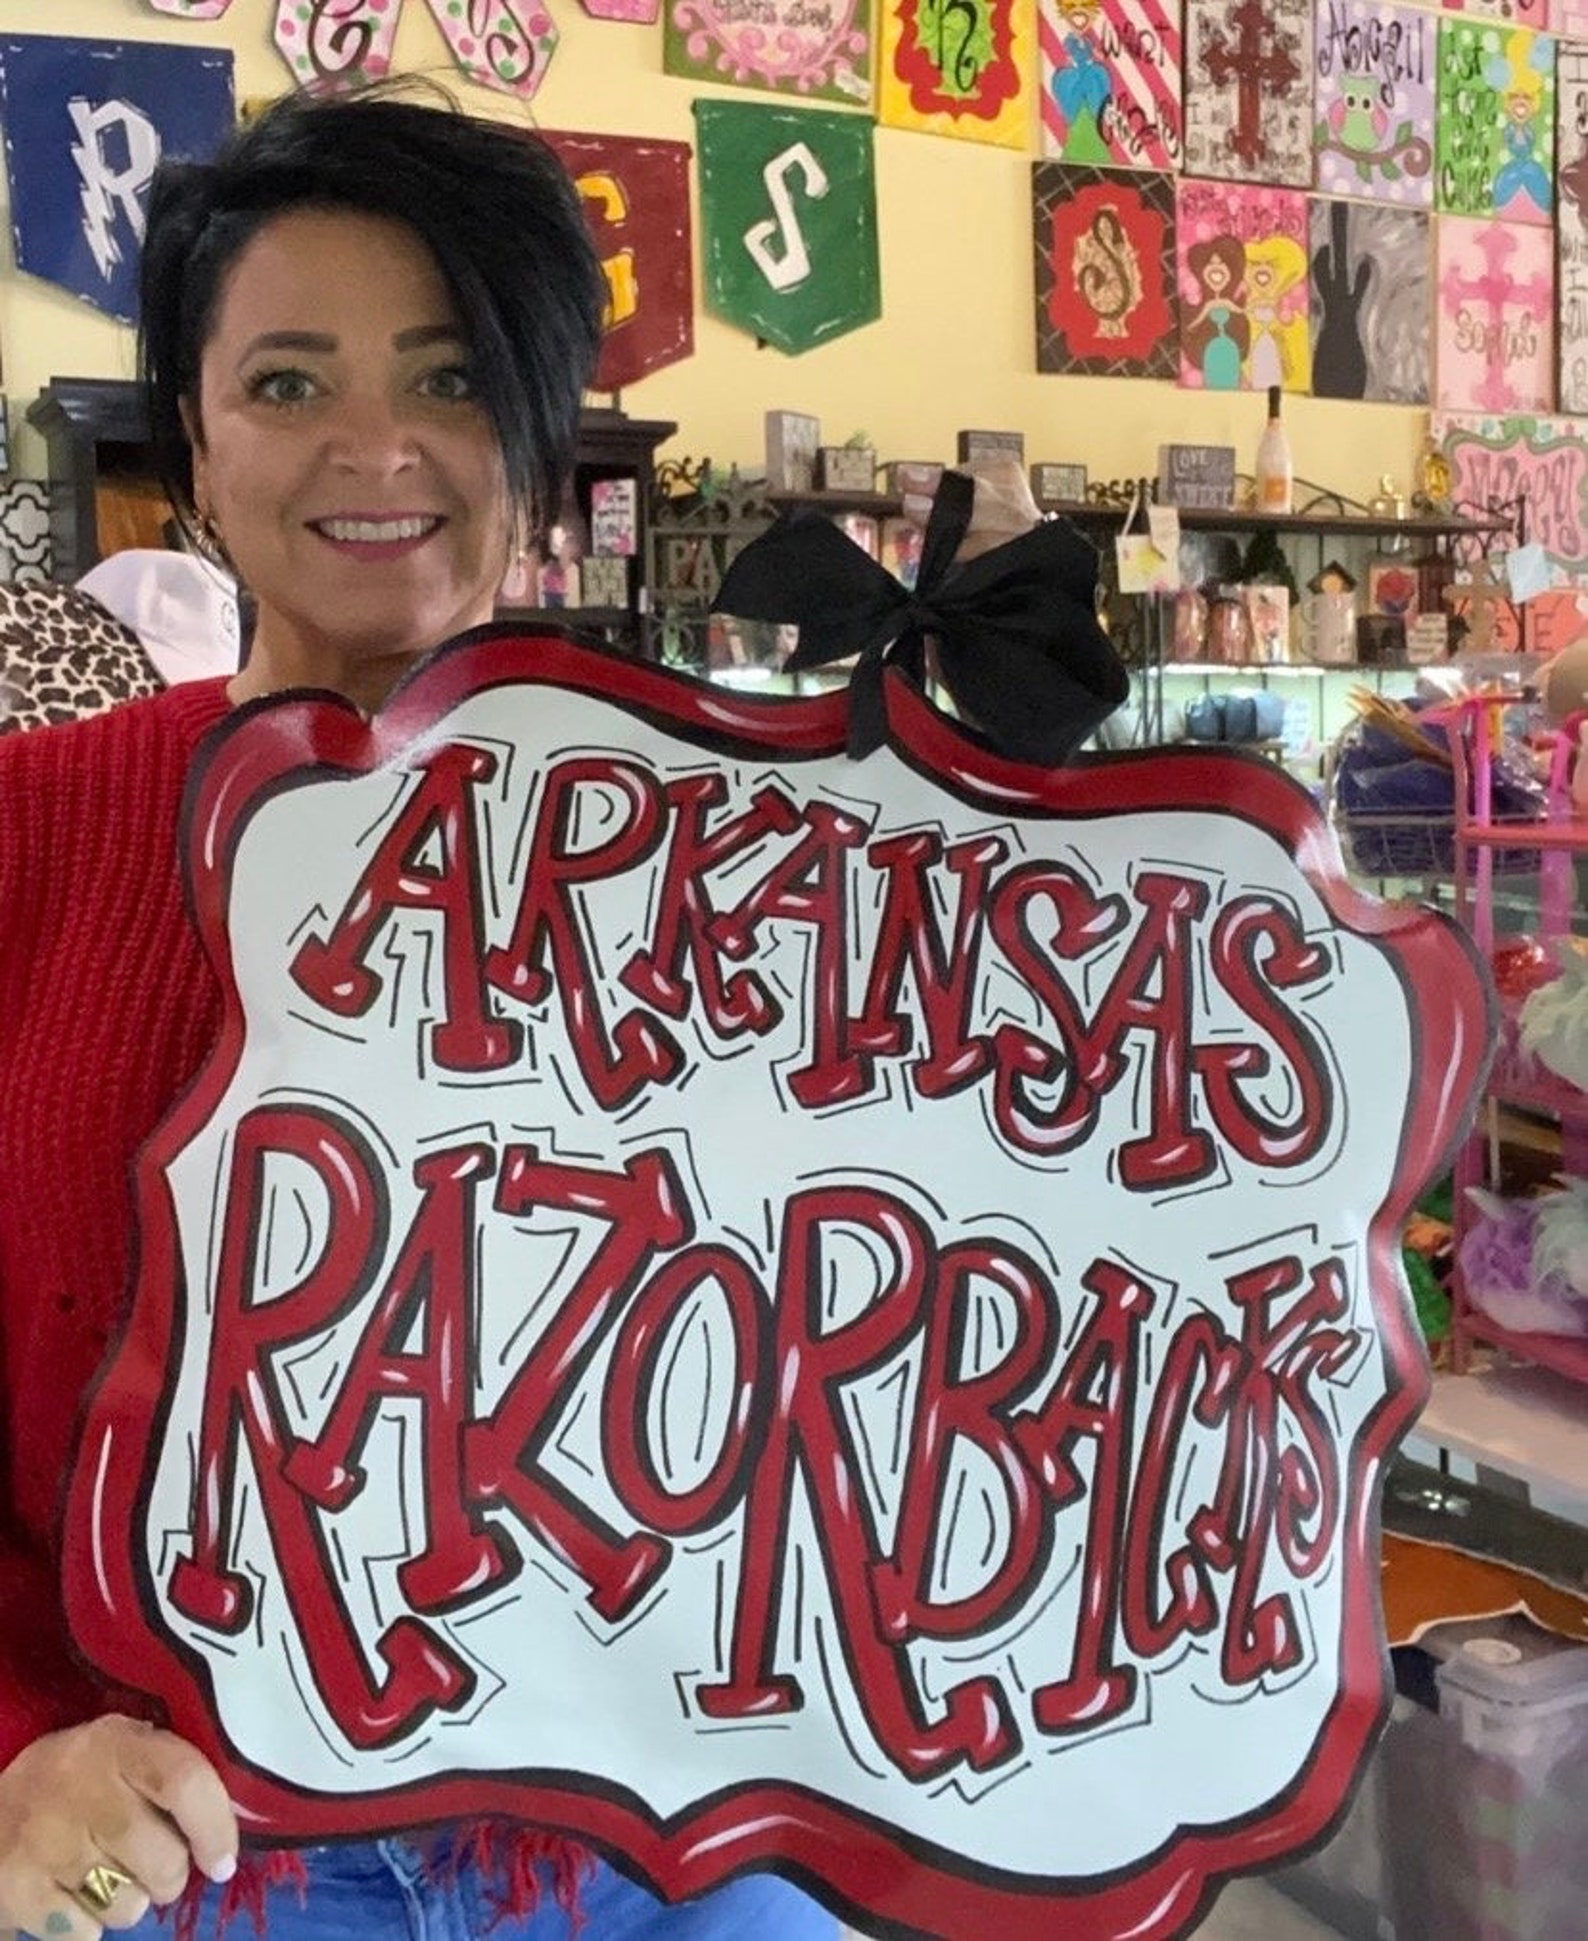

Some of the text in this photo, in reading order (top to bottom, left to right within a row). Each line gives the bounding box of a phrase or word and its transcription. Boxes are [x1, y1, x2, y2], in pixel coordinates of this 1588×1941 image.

[66, 98, 162, 284] R
[743, 141, 829, 294] S
[287, 742, 1333, 1191] ARKANSAS
[168, 1102, 1363, 1783] RAZORBACKS
